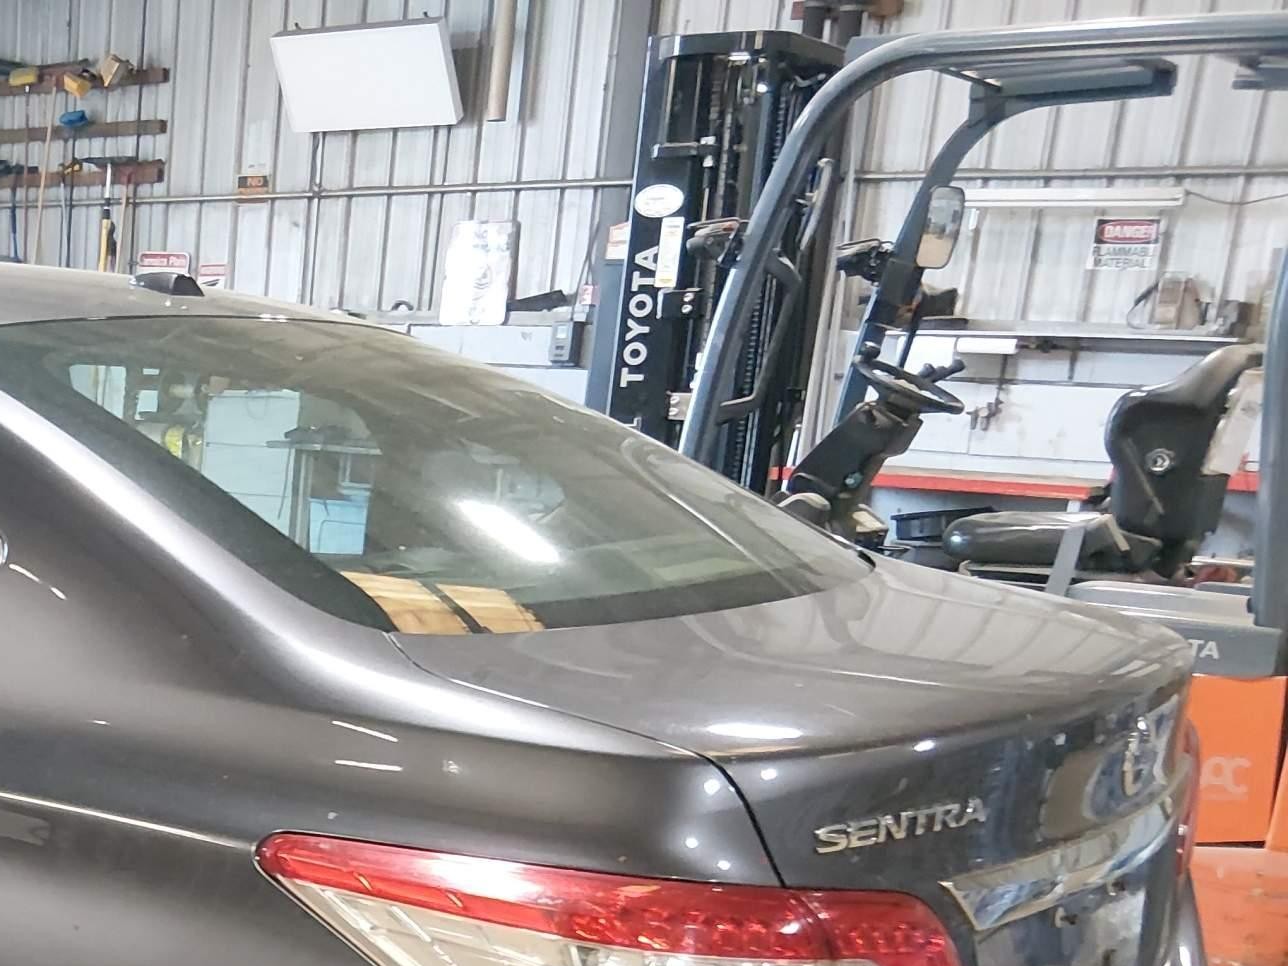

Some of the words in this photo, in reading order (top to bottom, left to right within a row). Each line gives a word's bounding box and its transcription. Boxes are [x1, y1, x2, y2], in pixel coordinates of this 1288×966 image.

[1092, 246, 1157, 257] FLAMMAB
[620, 246, 660, 388] TOYOTA
[814, 797, 987, 854] SENTRA
